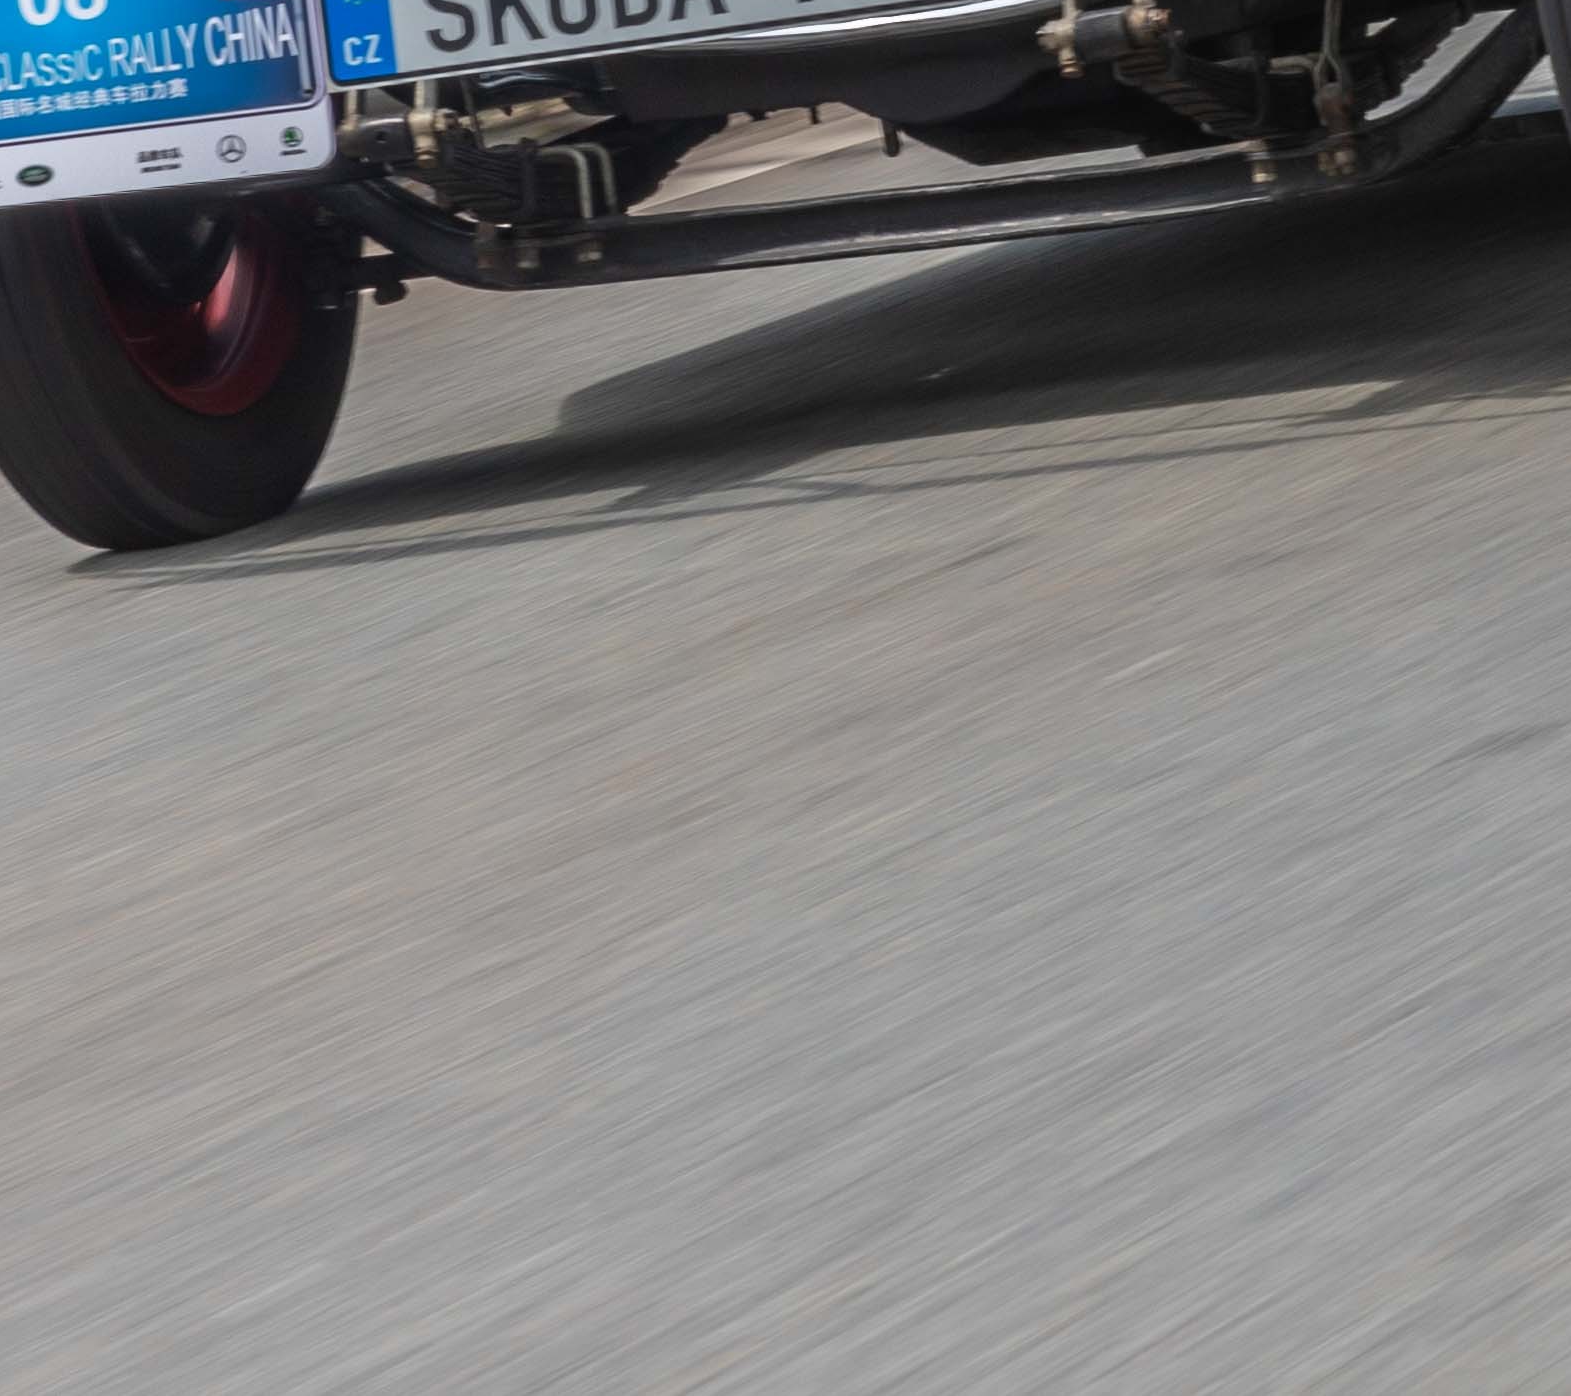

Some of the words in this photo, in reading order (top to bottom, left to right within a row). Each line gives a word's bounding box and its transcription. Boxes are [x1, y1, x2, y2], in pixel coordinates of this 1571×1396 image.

[107, 22, 198, 77] RALLY
[204, 2, 299, 67] CHINA
[342, 34, 383, 67] CZ
